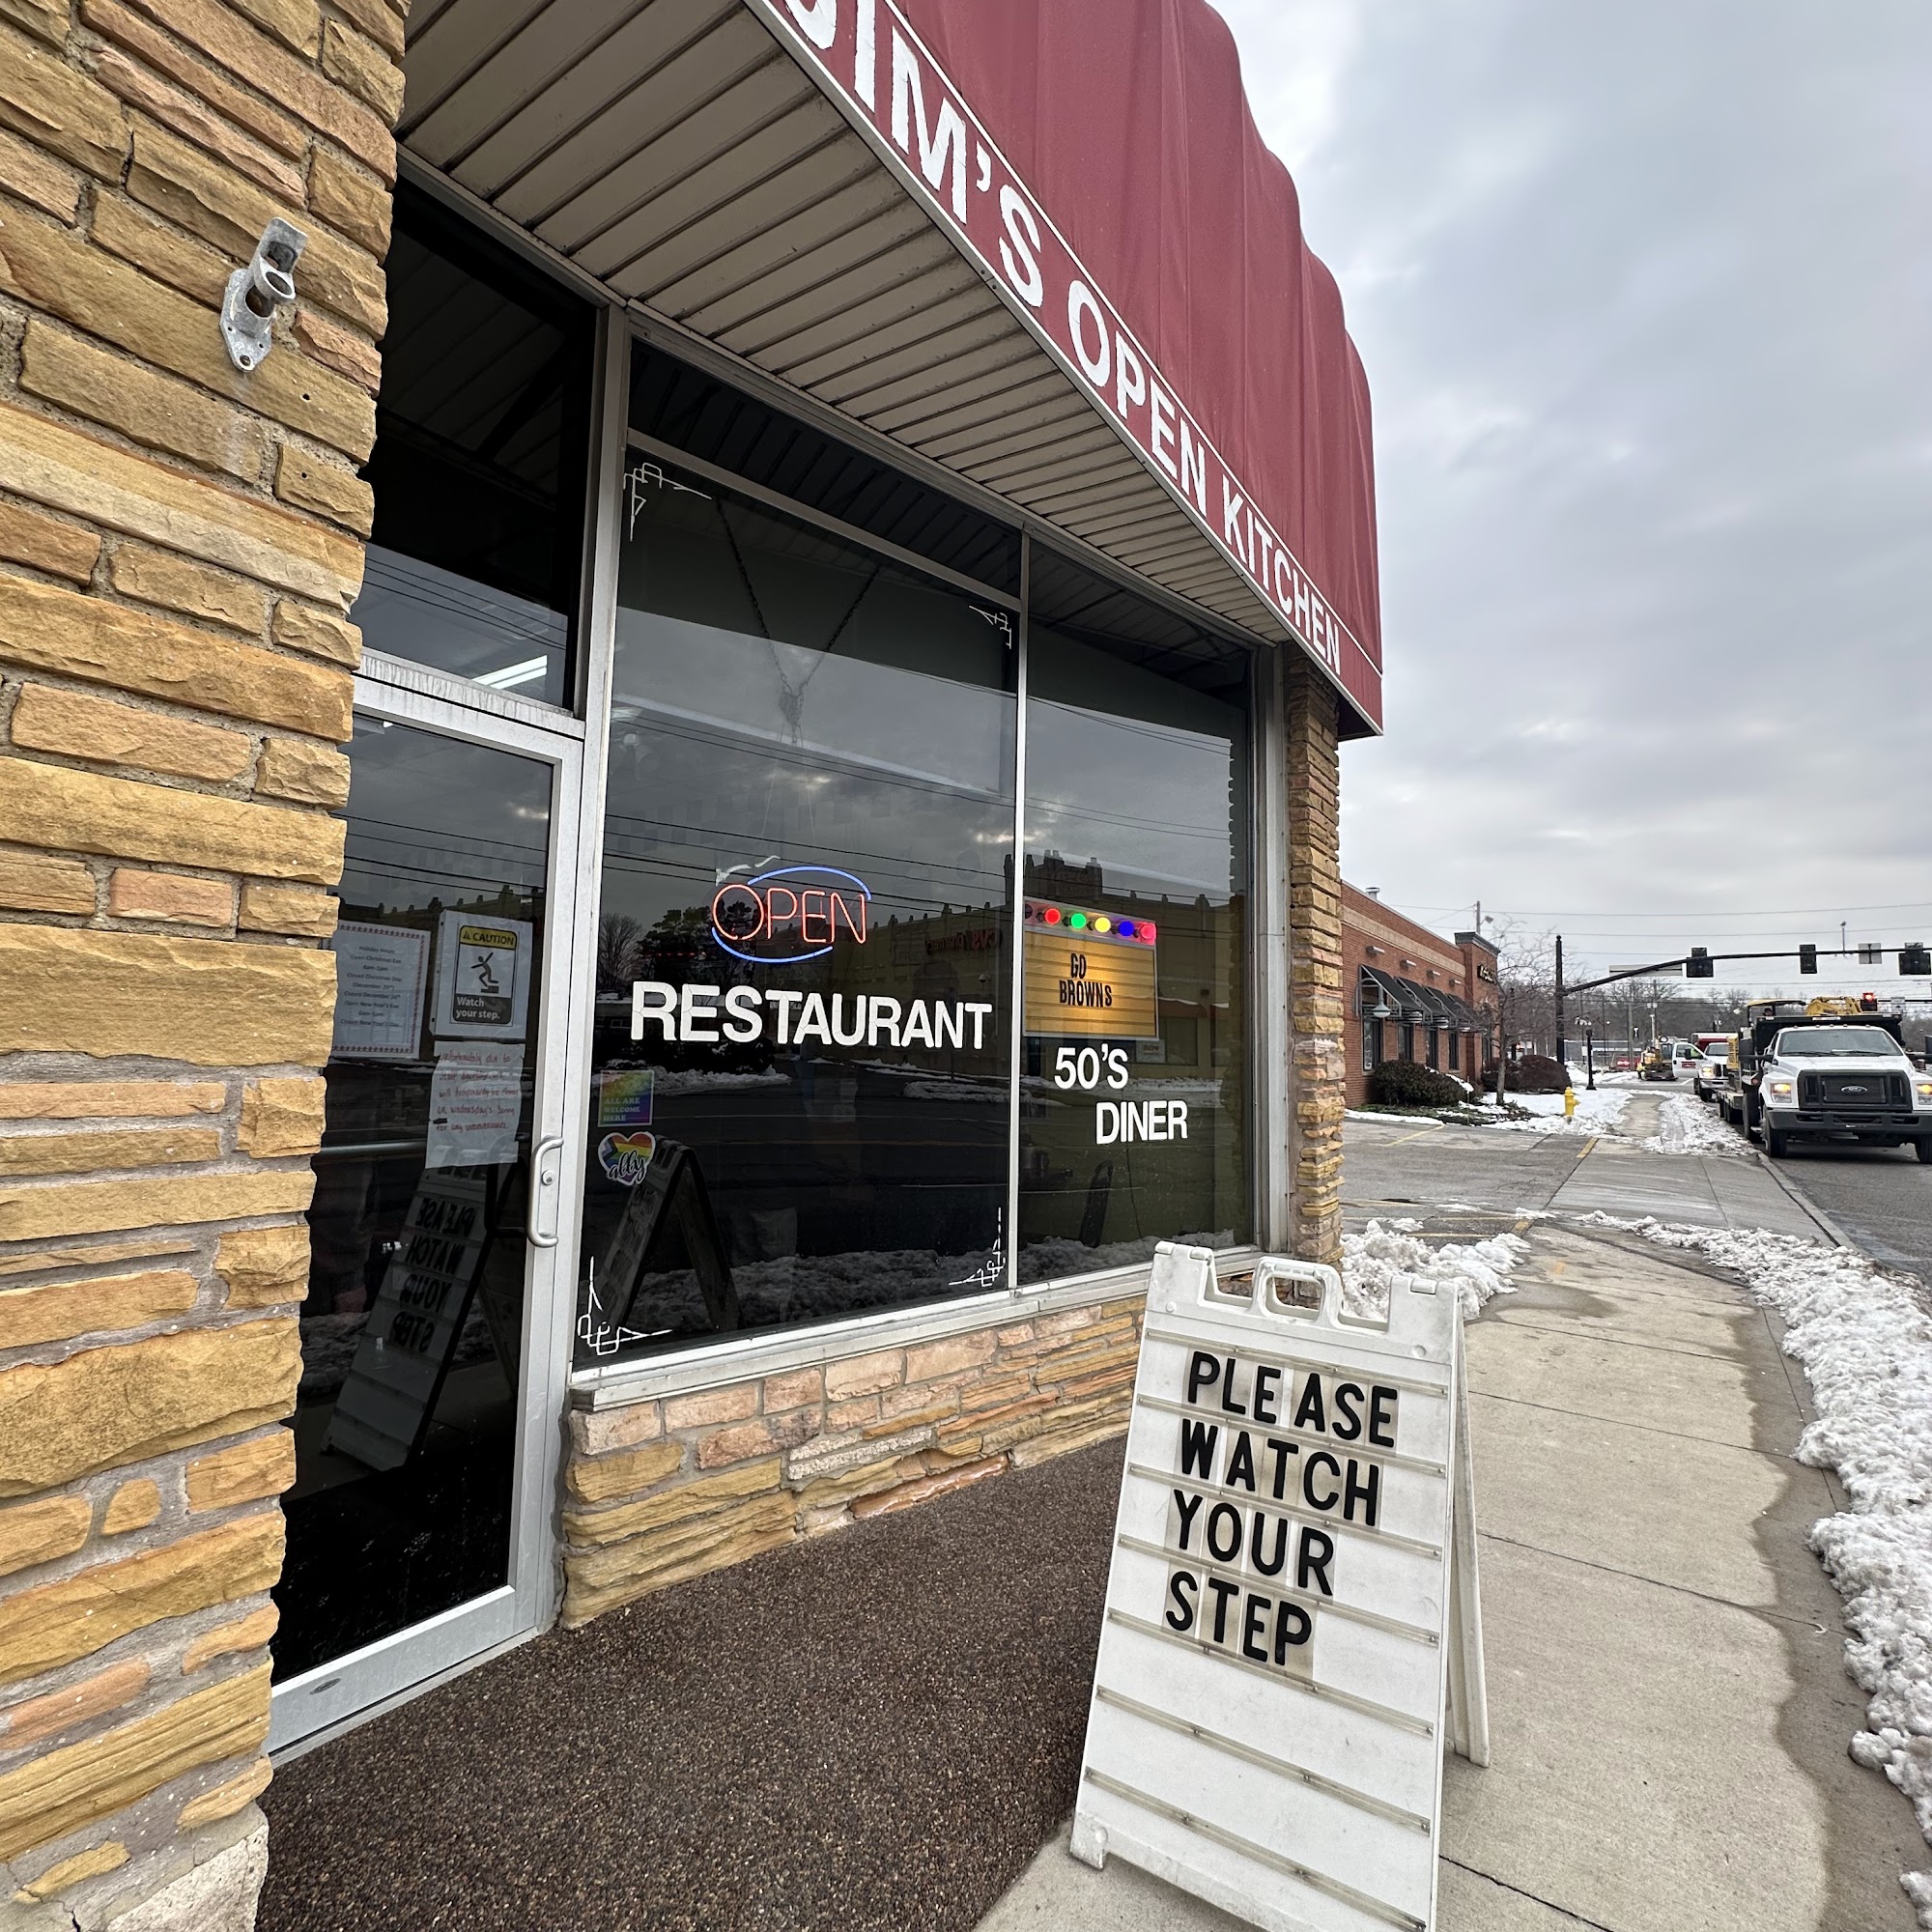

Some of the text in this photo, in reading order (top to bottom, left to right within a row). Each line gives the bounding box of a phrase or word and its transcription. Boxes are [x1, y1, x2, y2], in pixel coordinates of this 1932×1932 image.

[1067, 280, 1207, 517] OPEN
[1222, 473, 1341, 675] KITCHEN
[712, 883, 867, 944] OPEN
[472, 932, 514, 946] CAUTION
[1070, 952, 1087, 979] GO
[456, 1009, 500, 1021] your step.
[457, 996, 484, 1007] Watch
[630, 980, 993, 1050] RESTAURANT
[1059, 980, 1113, 1008] BROWNS
[486, 1053, 497, 1063] due
[502, 1052, 511, 1063] to
[1054, 1042, 1129, 1090] 50'S
[1096, 1100, 1188, 1145] DINER
[1187, 1350, 1398, 1448] PLEASE
[1180, 1418, 1379, 1526] WATCH
[1174, 1489, 1334, 1597] YOUR
[1165, 1571, 1312, 1666] STEP
